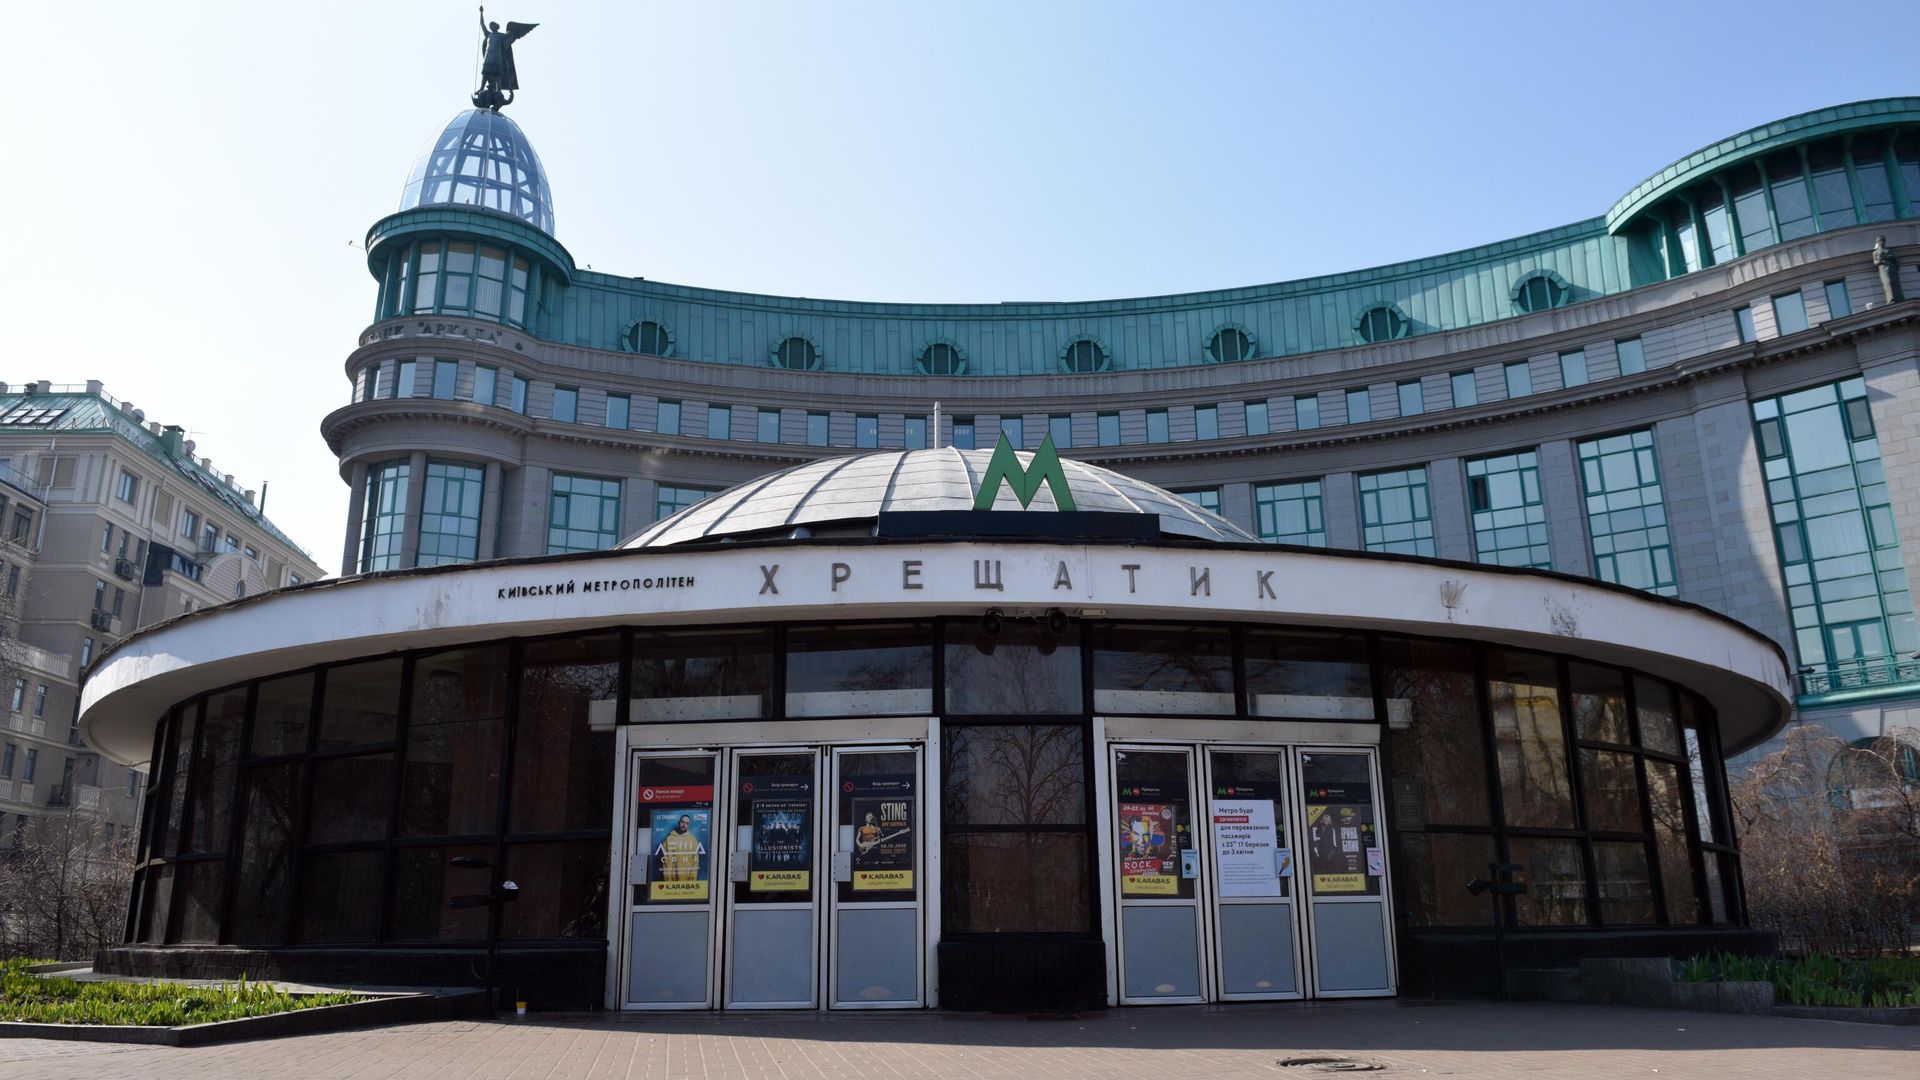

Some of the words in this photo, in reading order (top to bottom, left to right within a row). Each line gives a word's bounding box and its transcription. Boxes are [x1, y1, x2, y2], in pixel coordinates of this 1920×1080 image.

[498, 580, 575, 599] КИЇВСЬКИЙ
[583, 577, 695, 593] МЕТРОПОЛІТЕН
[759, 560, 1276, 599] ХРЕЩАТИК
[880, 802, 907, 821] STING
[1238, 806, 1254, 814] буде
[1123, 861, 1152, 869] ROCK
